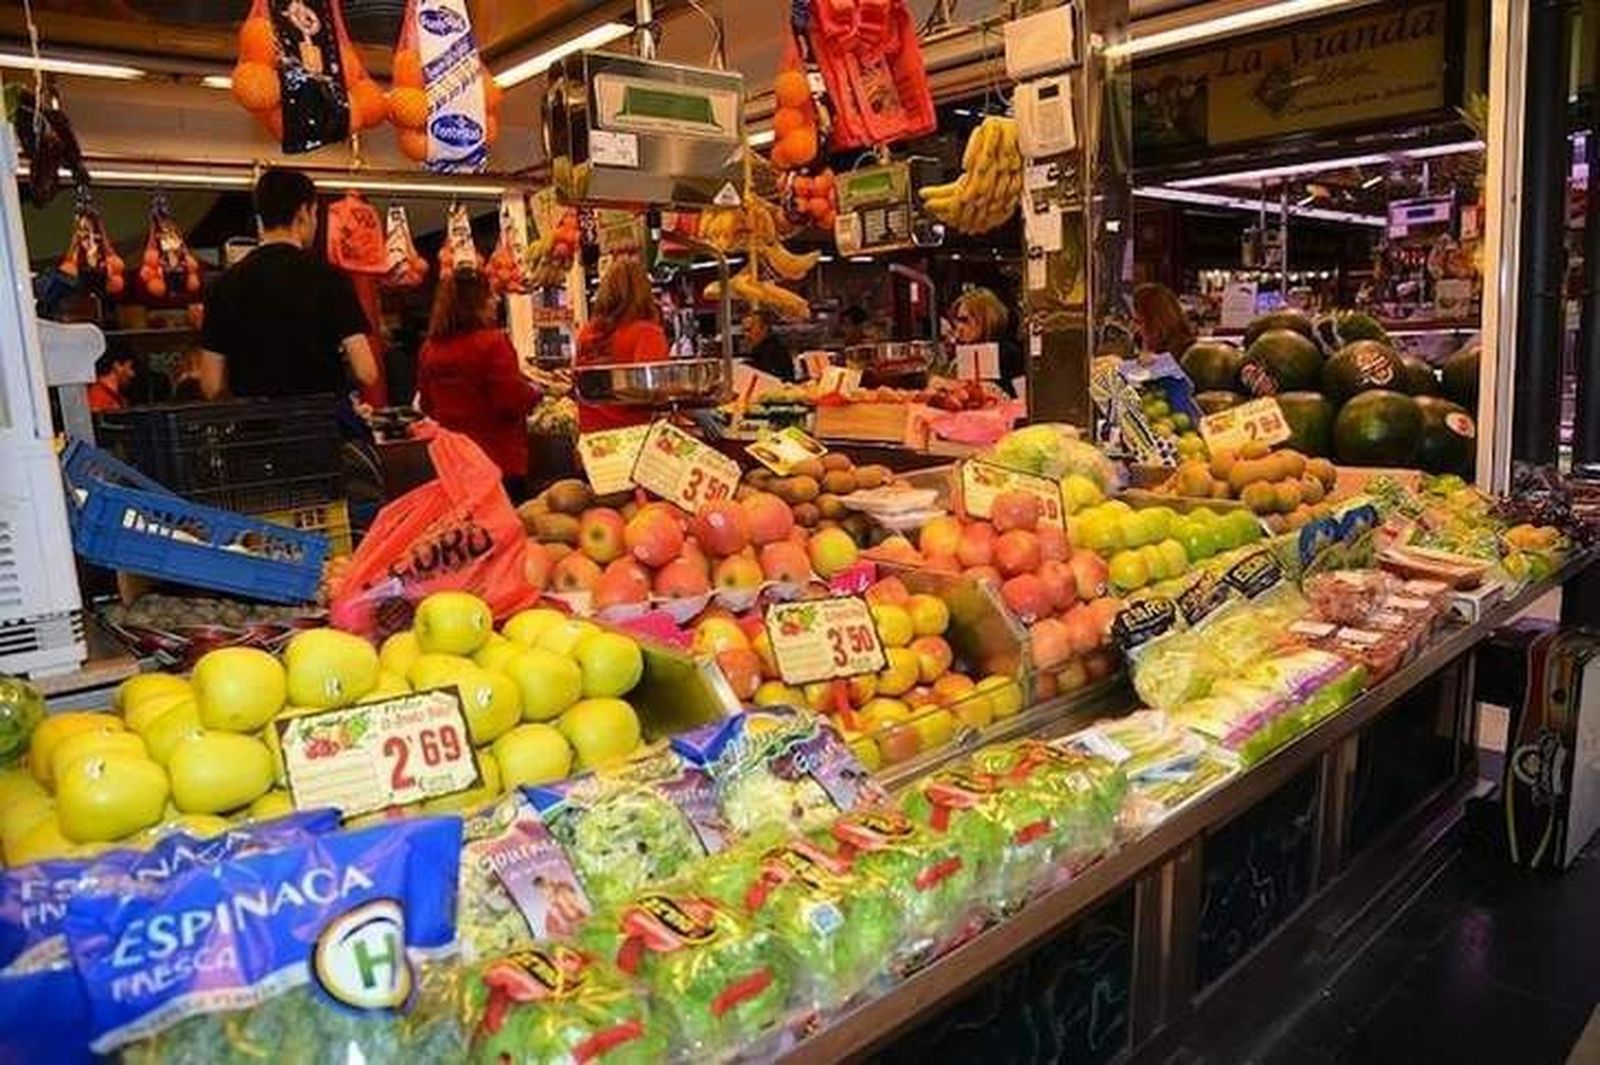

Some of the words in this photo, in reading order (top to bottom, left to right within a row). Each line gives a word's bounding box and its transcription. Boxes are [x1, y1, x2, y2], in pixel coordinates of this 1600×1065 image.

[1217, 47, 1263, 76] La
[1287, 5, 1437, 65] Vianda
[383, 724, 461, 791] 2'69
[110, 864, 375, 970] ESPINACA
[352, 932, 397, 990] H
